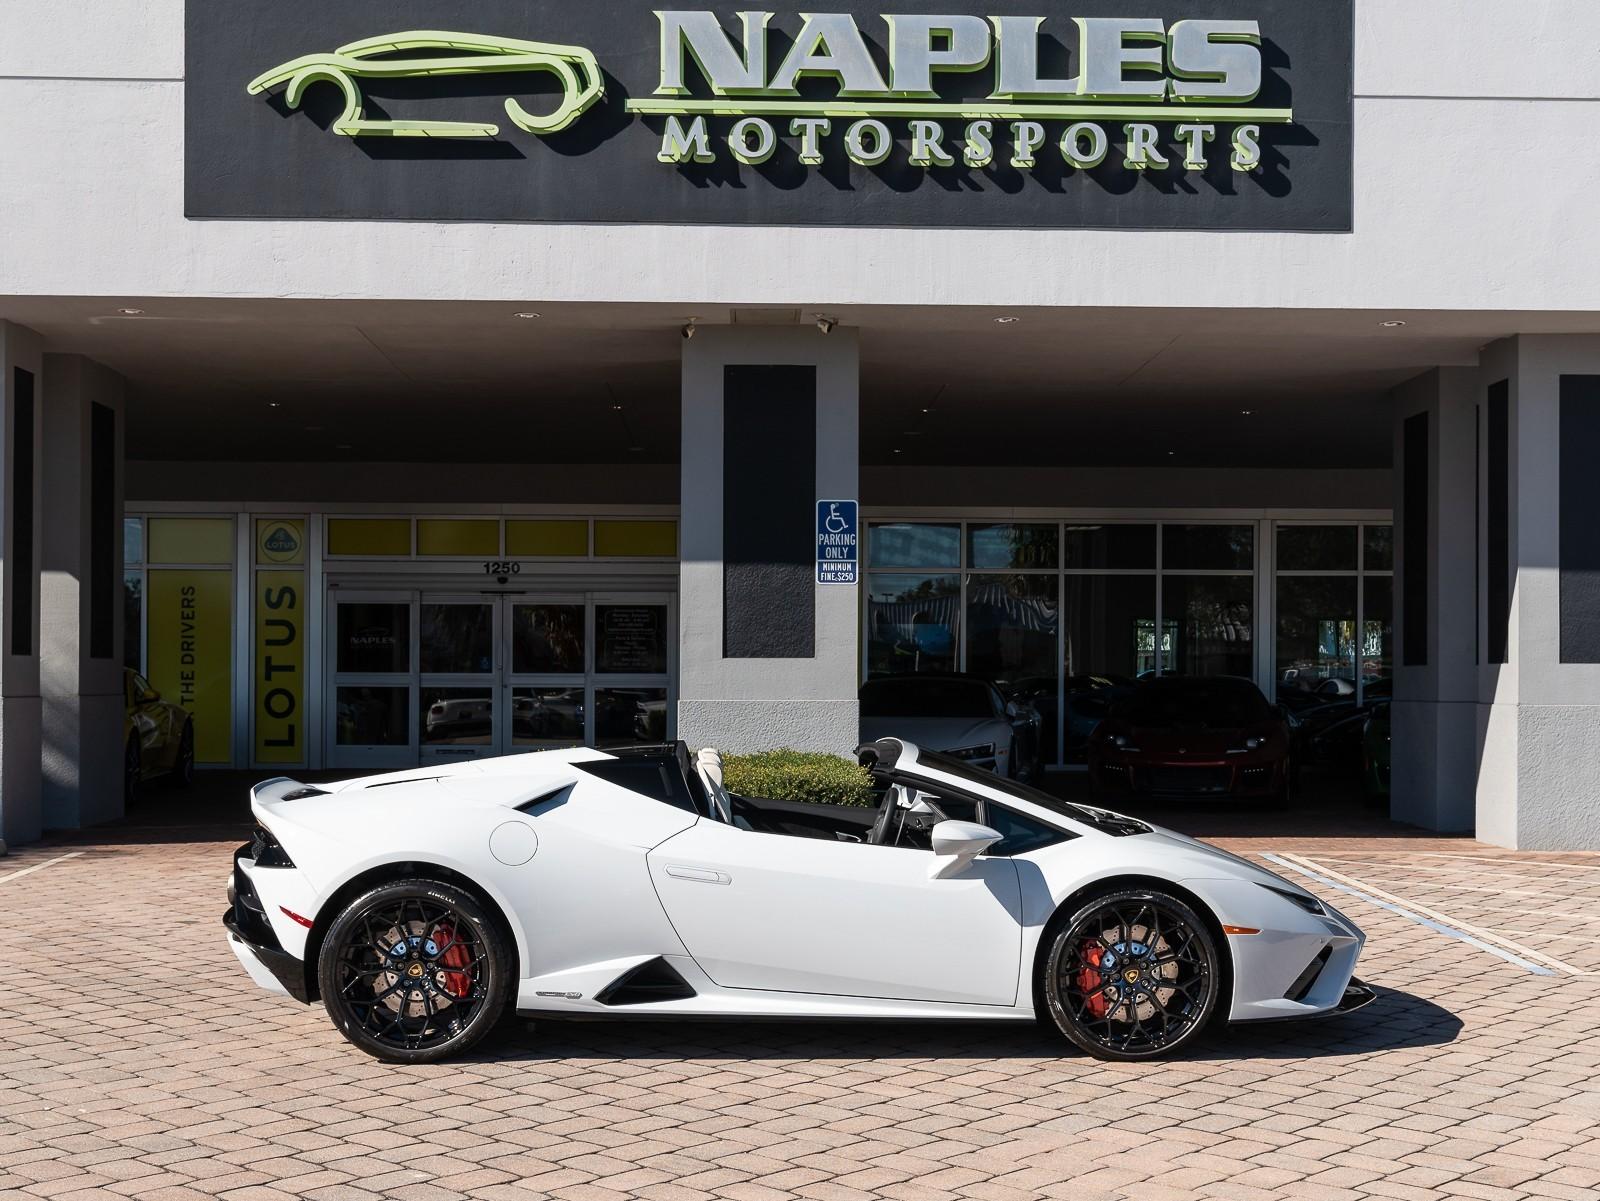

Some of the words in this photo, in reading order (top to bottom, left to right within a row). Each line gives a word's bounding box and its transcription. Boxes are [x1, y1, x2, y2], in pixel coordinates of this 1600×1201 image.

[652, 10, 1262, 103] NAPLES
[657, 115, 1261, 171] MOTORSPORTS
[266, 541, 297, 549] LOTUS
[818, 534, 856, 545] PARKING
[825, 546, 849, 559] ONLY
[483, 562, 520, 575] 1250
[822, 562, 852, 571] MINIMUM
[820, 572, 836, 581] FINE
[838, 572, 854, 582] $250
[180, 585, 195, 665] DRIVERS
[350, 636, 396, 645] NAPLES
[264, 585, 297, 748] LOTUS
[180, 670, 195, 706] THE
